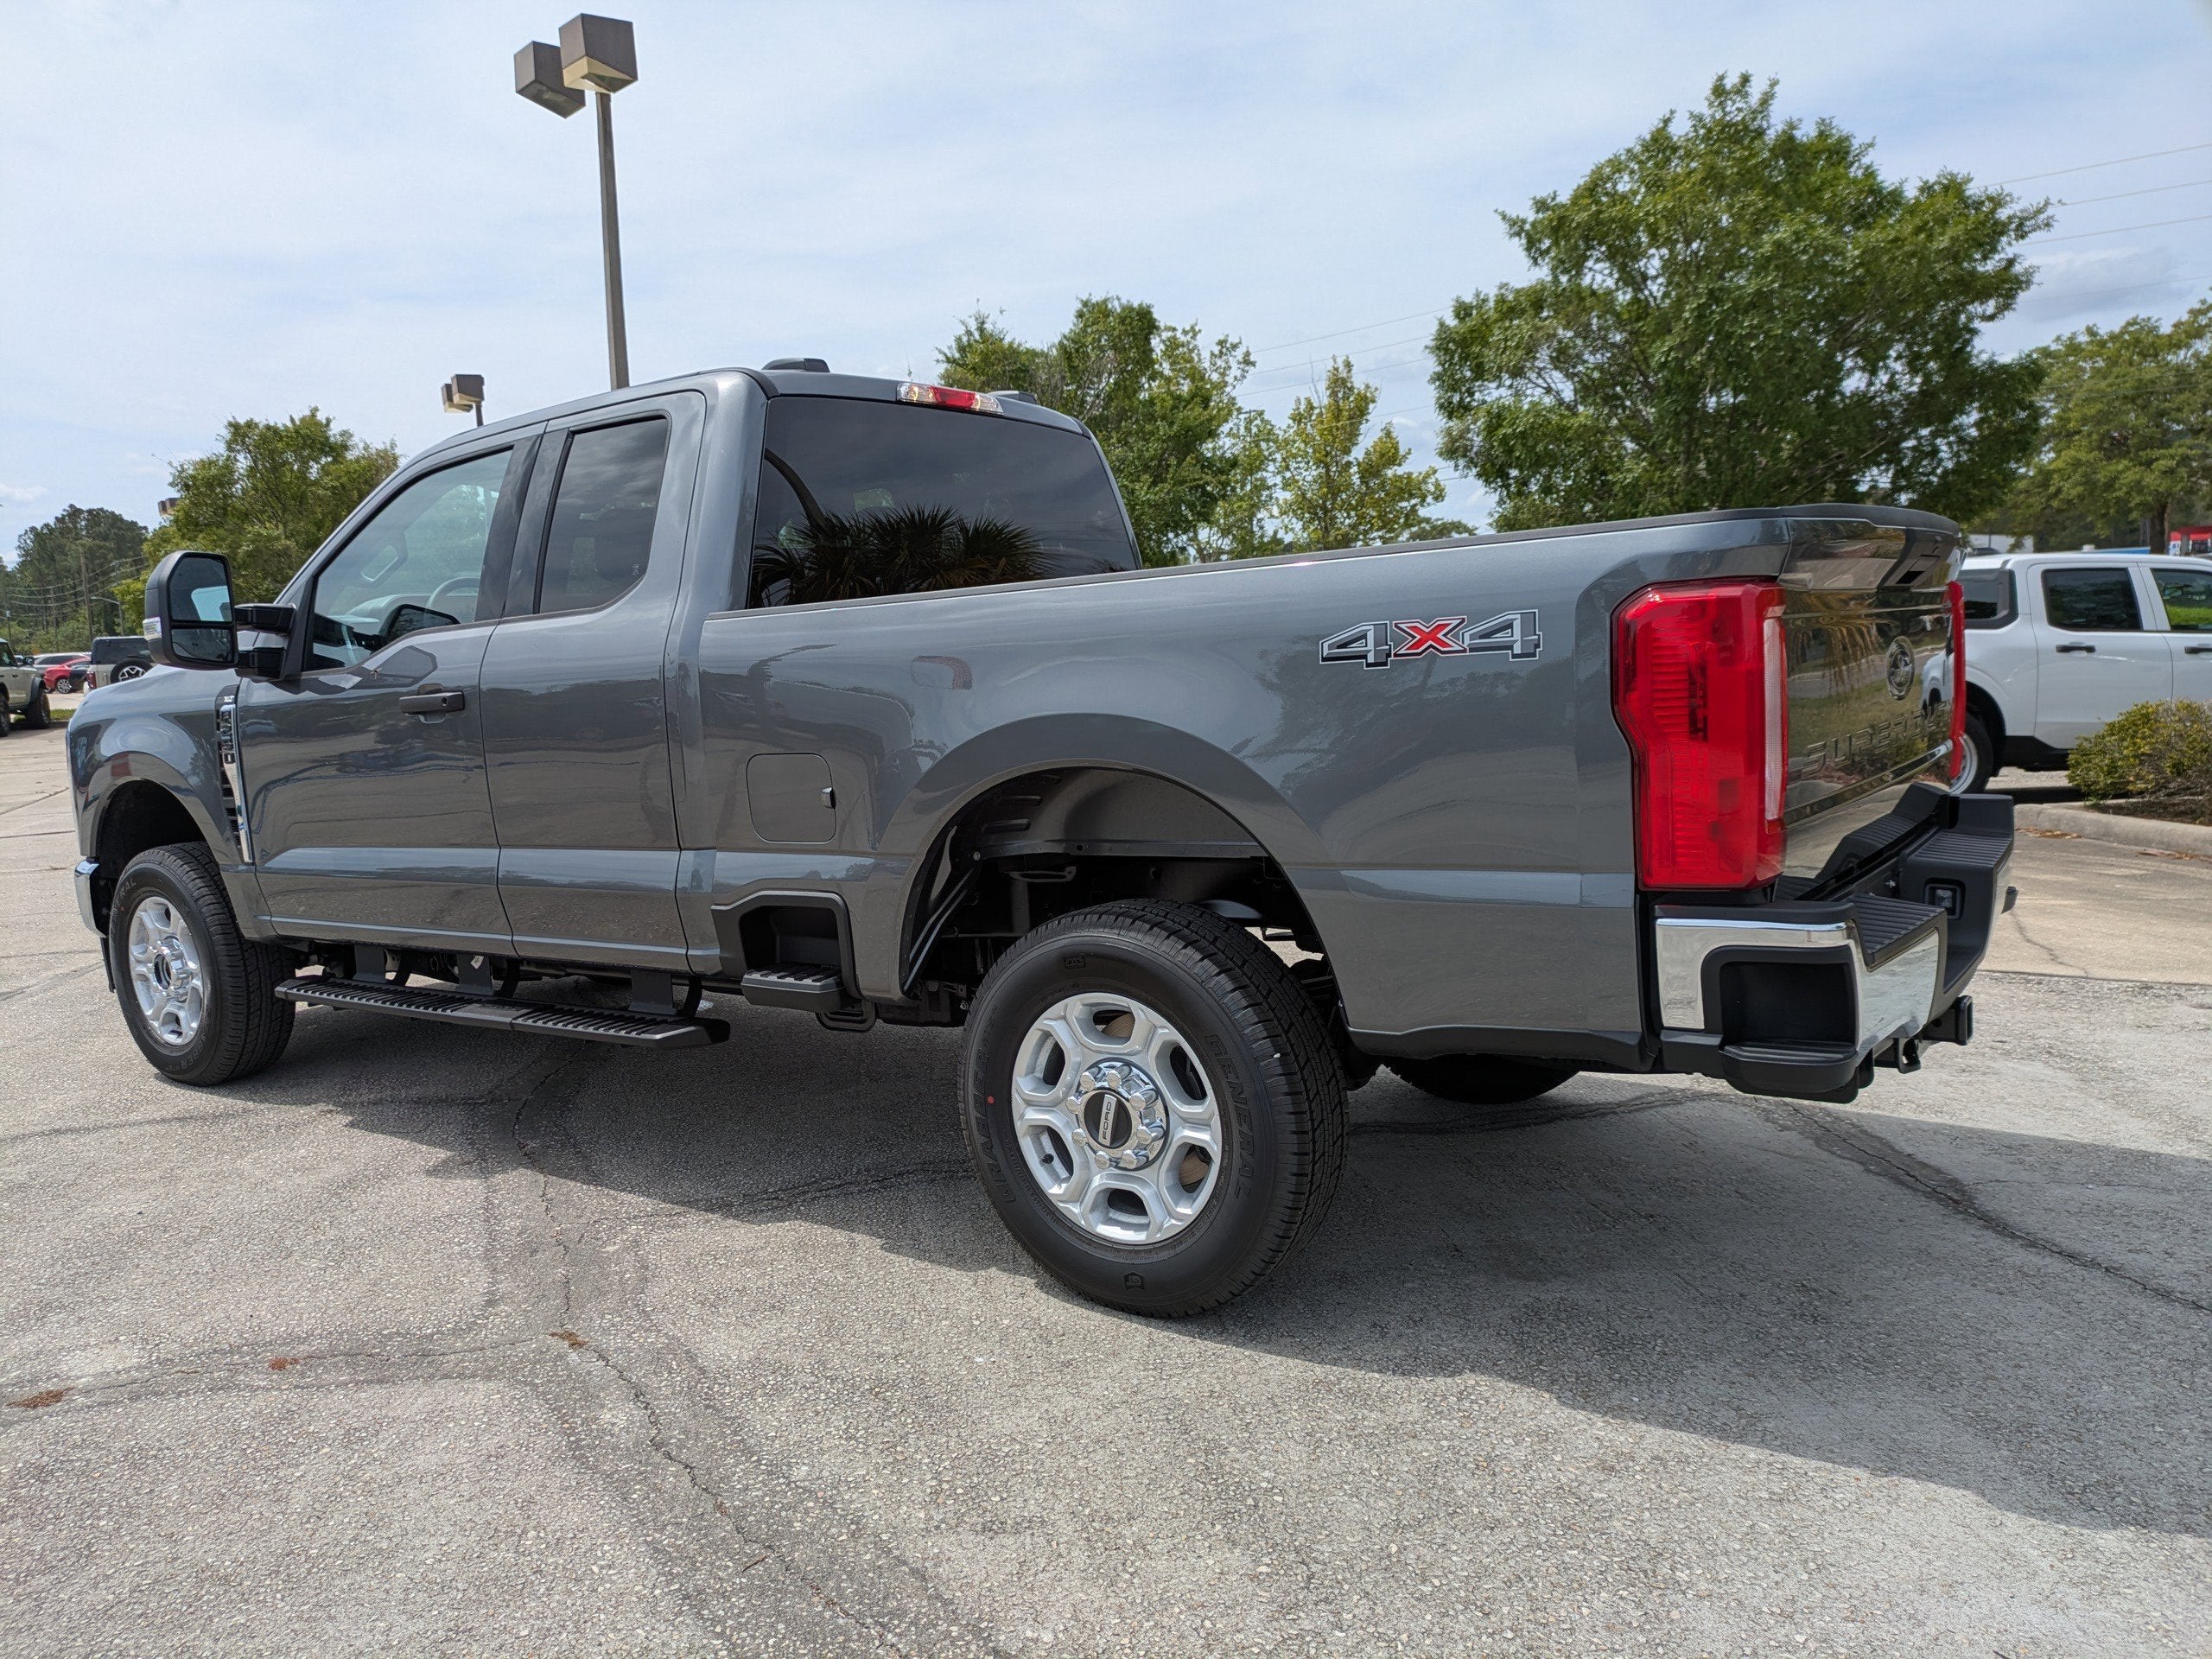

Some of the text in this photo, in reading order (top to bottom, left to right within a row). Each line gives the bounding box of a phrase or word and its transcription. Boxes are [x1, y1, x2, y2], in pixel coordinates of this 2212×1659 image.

[1802, 716, 1908, 779] SUPER
[973, 1047, 1016, 1204] GRABBER
[1102, 1100, 1112, 1141] FORD
[1207, 1034, 1254, 1199] GENERAL
